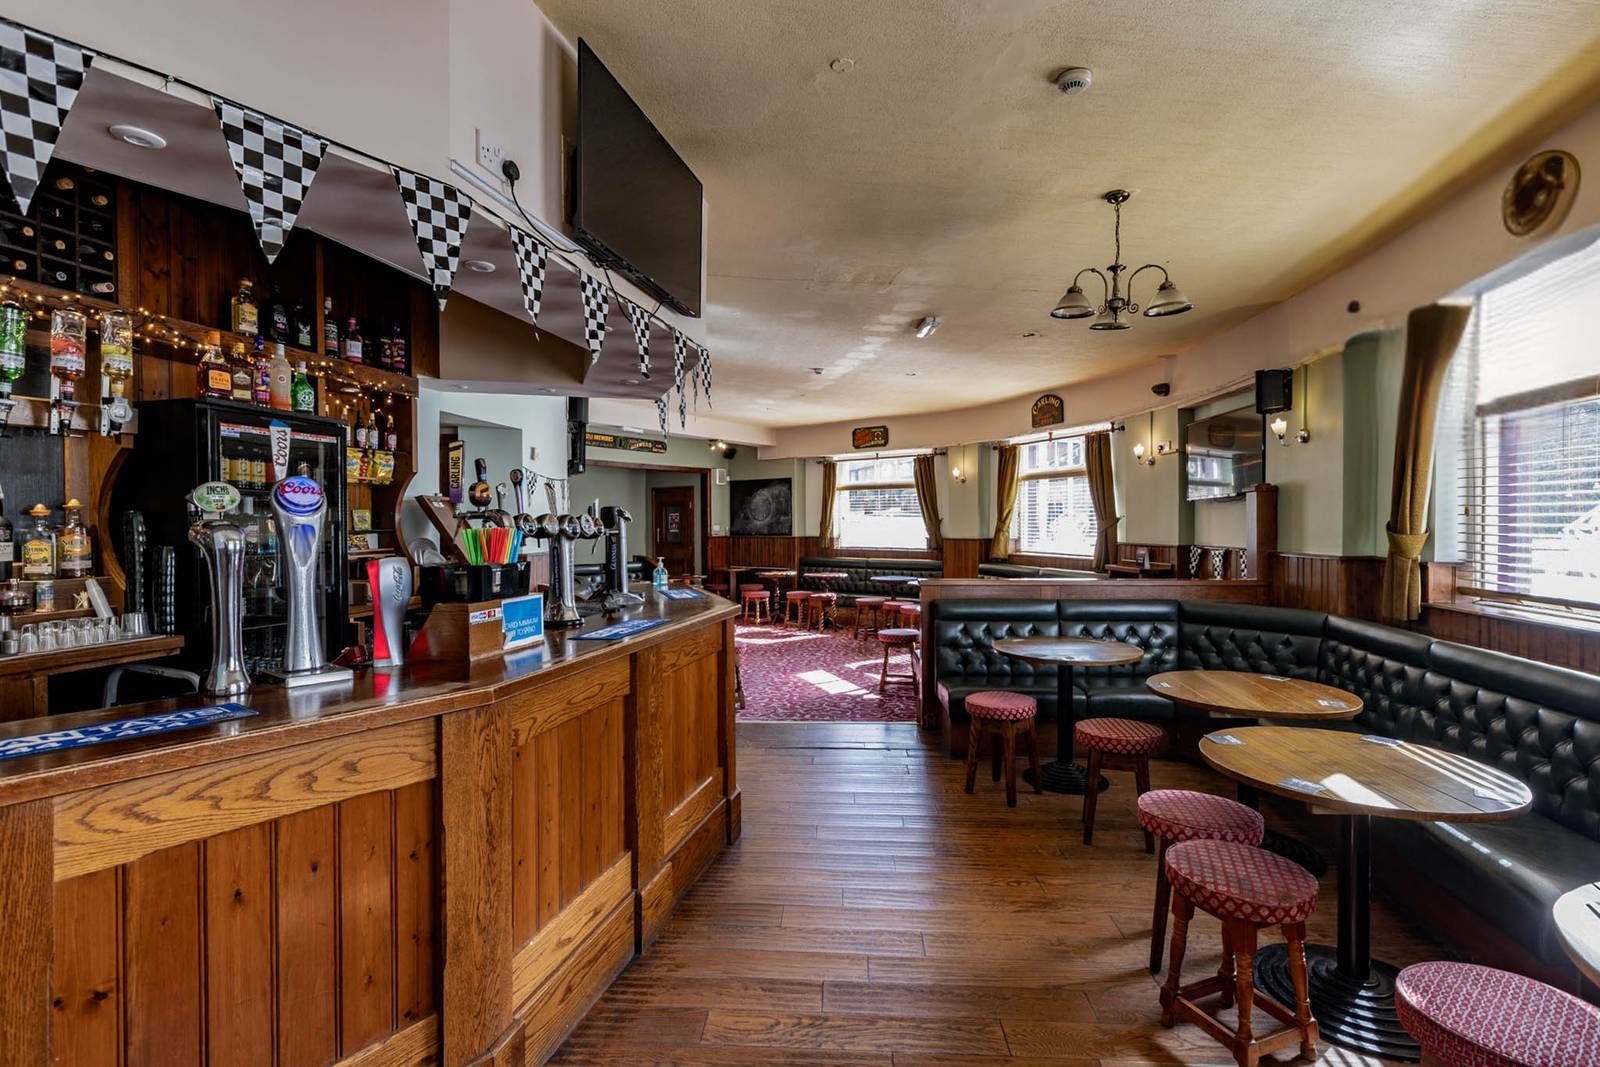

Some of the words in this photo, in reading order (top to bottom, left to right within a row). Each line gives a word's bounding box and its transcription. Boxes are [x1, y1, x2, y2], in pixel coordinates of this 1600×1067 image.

[1033, 397, 1060, 415] CARLING
[275, 430, 288, 467] Coors
[451, 456, 461, 488] CARLING
[279, 481, 324, 497] Coors
